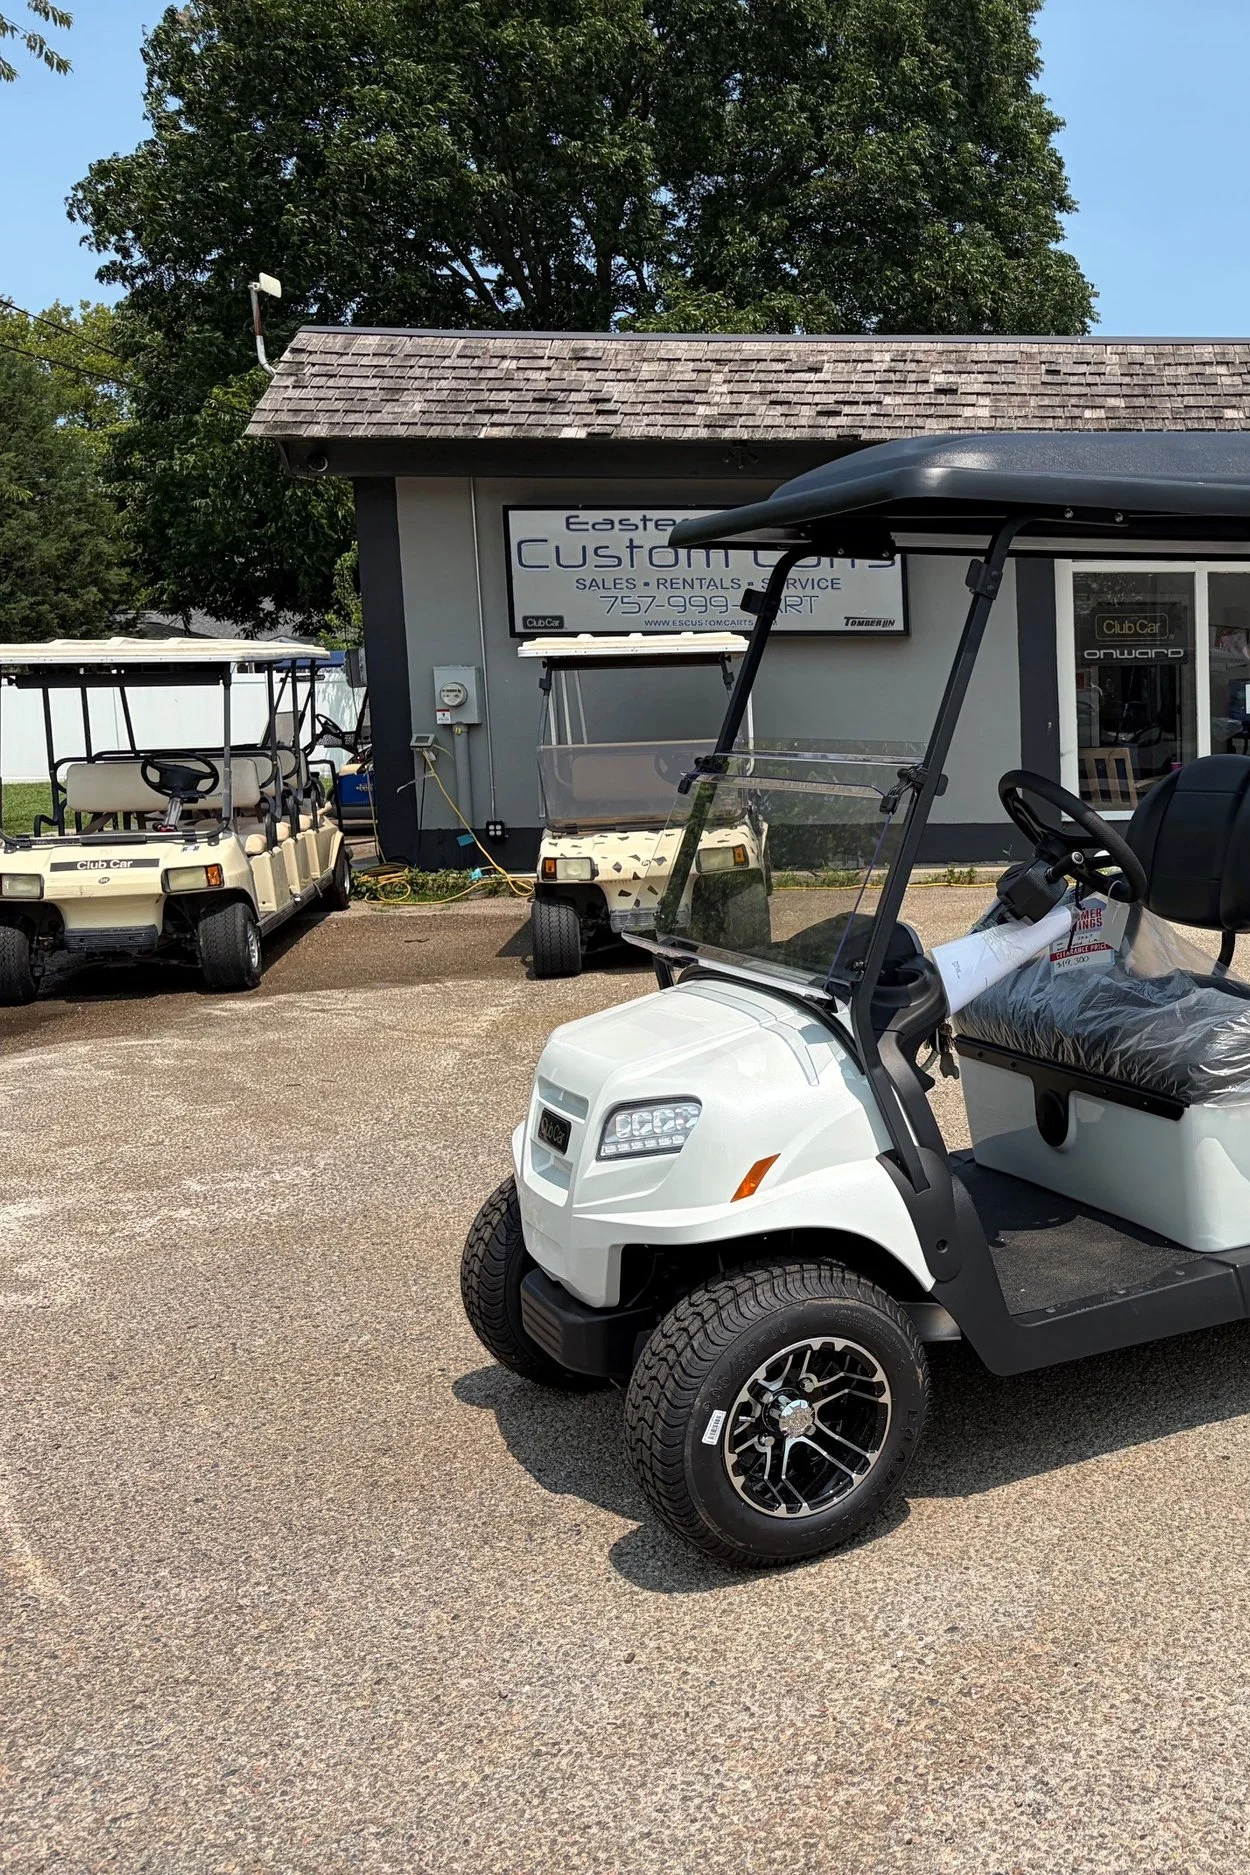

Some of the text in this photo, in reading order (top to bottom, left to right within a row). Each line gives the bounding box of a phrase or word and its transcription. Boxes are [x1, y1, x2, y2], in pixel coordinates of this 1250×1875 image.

[516, 537, 730, 570] Custom
[575, 577, 842, 591] SALES RENTALS SRVICE
[599, 595, 820, 615] 757-999-RT
[526, 618, 561, 627] Club Car
[844, 616, 896, 628] TOMBERLIN
[1103, 619, 1161, 634] Club Car
[77, 860, 133, 870] Club Car
[1080, 908, 1102, 921] MER
[1077, 918, 1103, 931] INGS
[1056, 945, 1089, 959] CLEARANCE
[1090, 943, 1108, 951] PRICE
